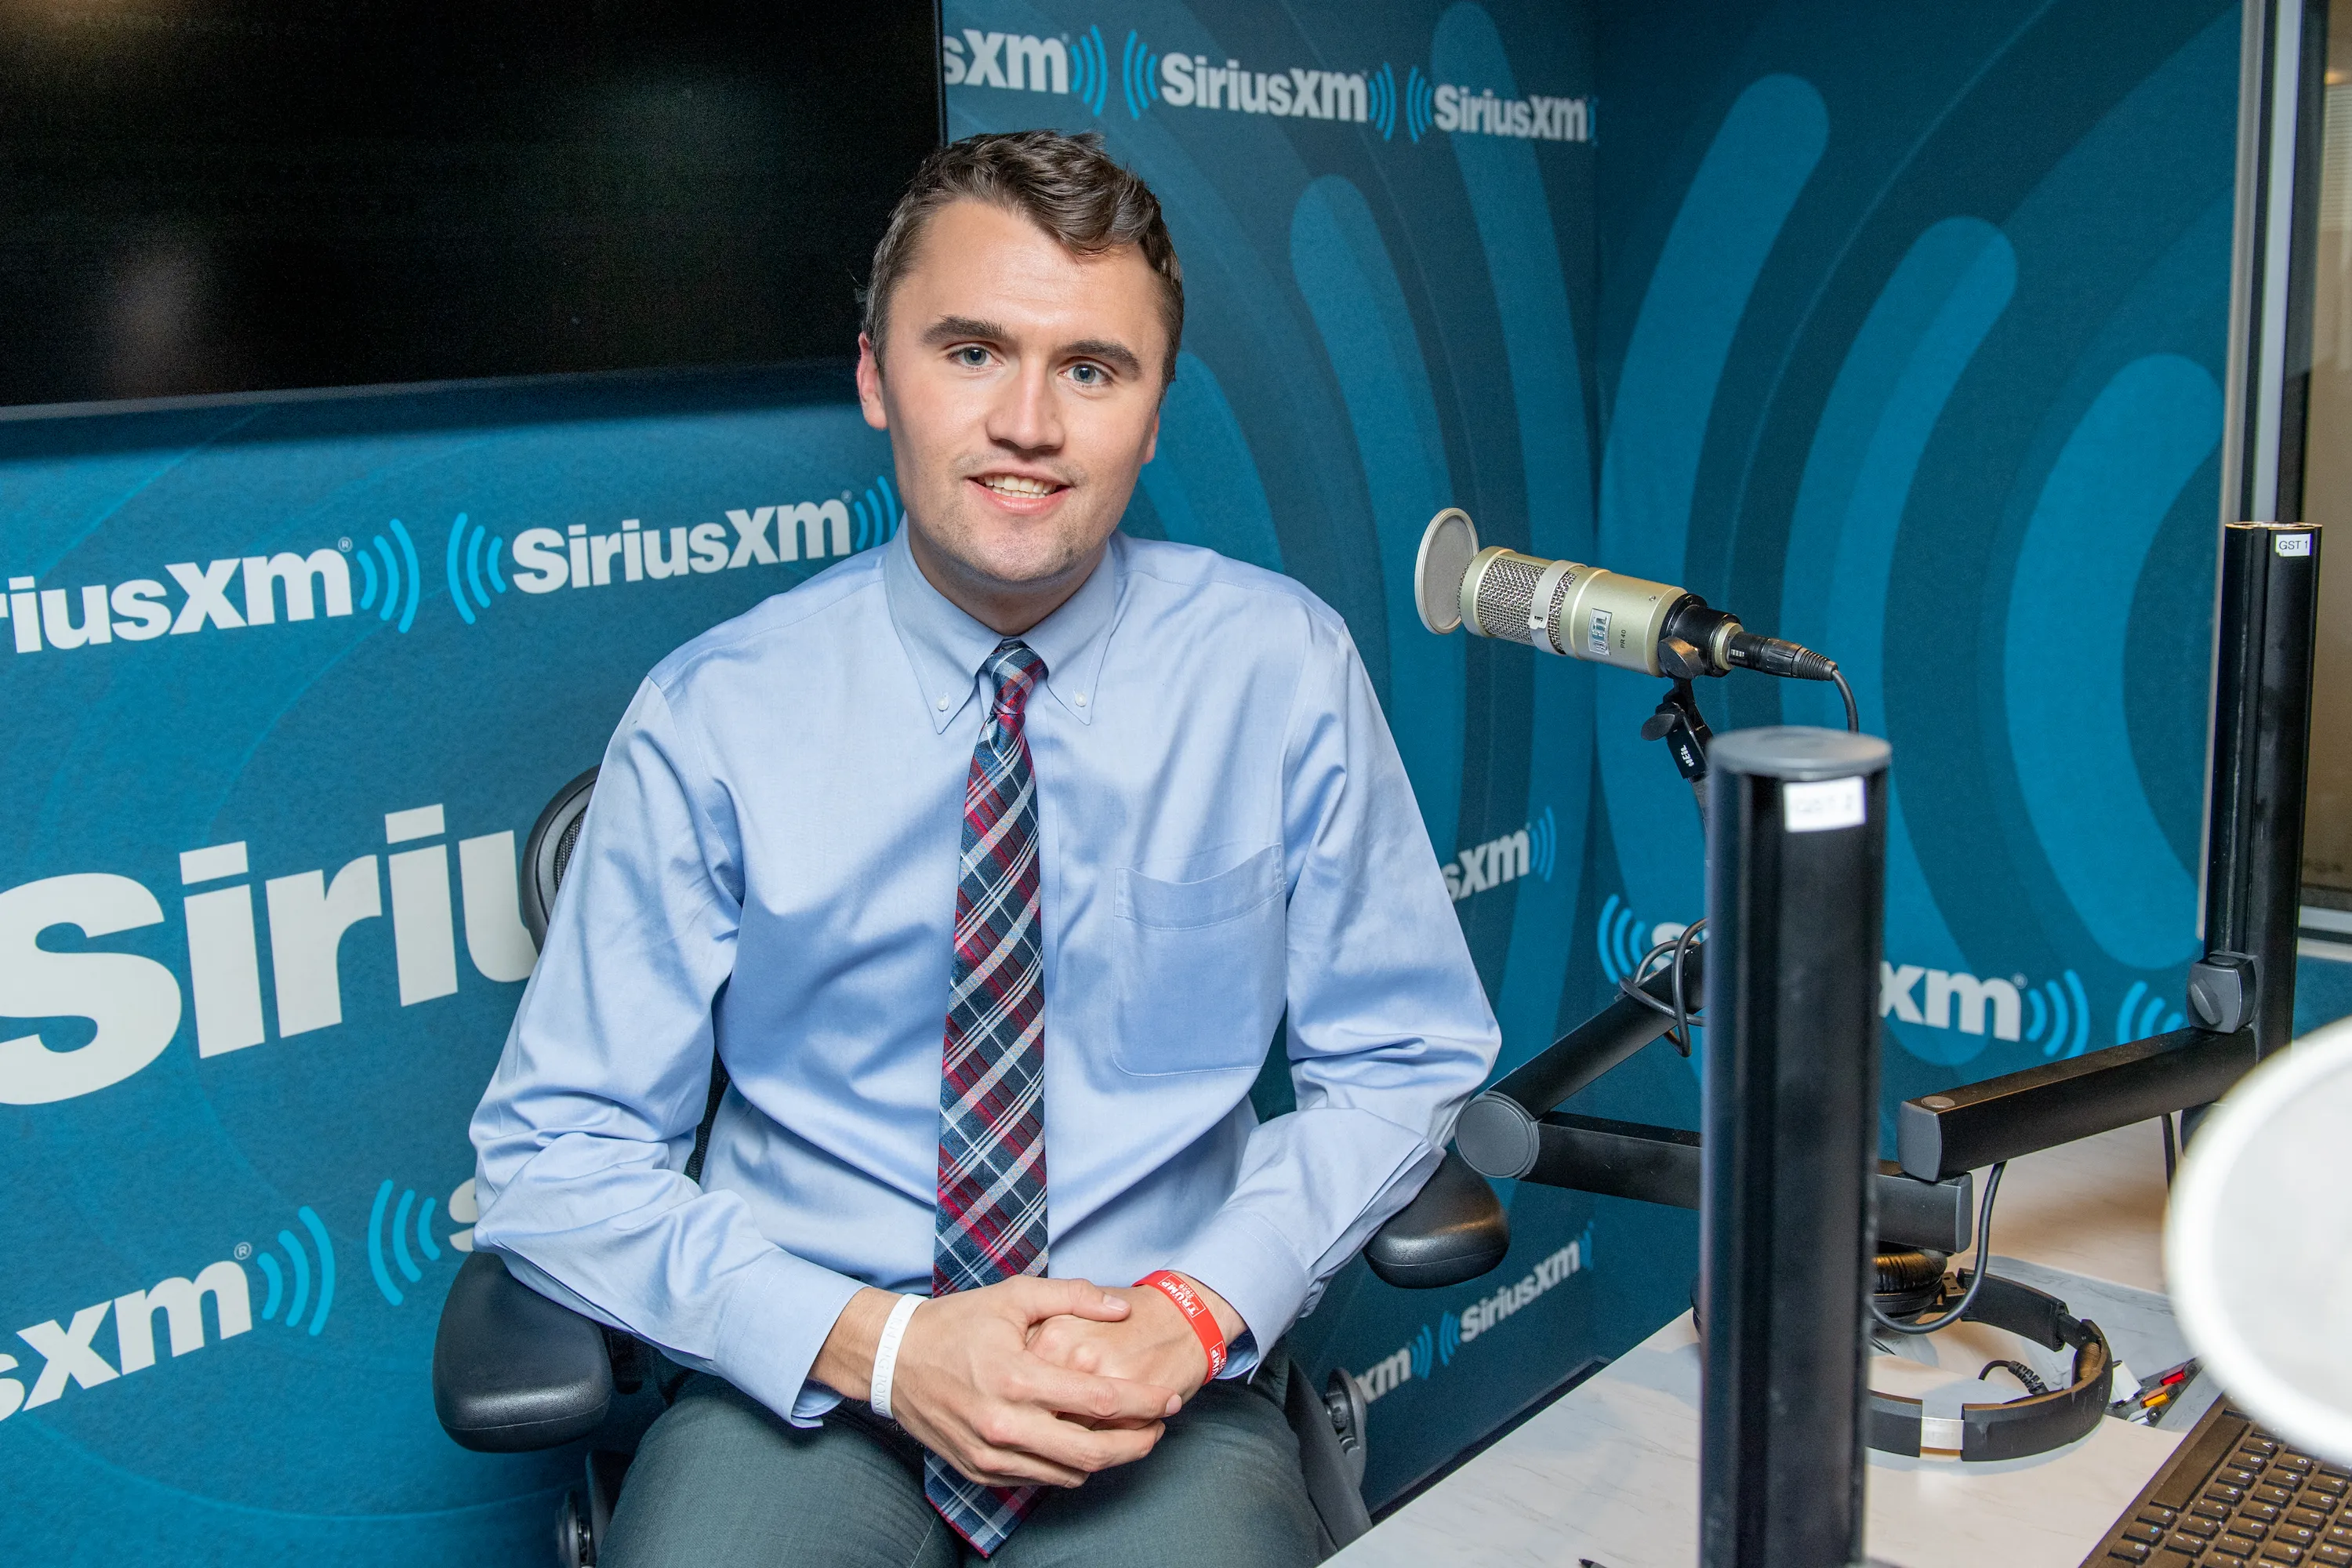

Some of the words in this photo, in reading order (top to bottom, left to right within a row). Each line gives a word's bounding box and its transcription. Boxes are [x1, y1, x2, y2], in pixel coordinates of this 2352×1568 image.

[2278, 540, 2302, 550] GST
[0, 548, 353, 653] iusXm
[1621, 630, 1627, 638] 40
[1620, 639, 1627, 649] PR
[1178, 1283, 1195, 1299] 2020
[1160, 1280, 1196, 1316] TRUMP
